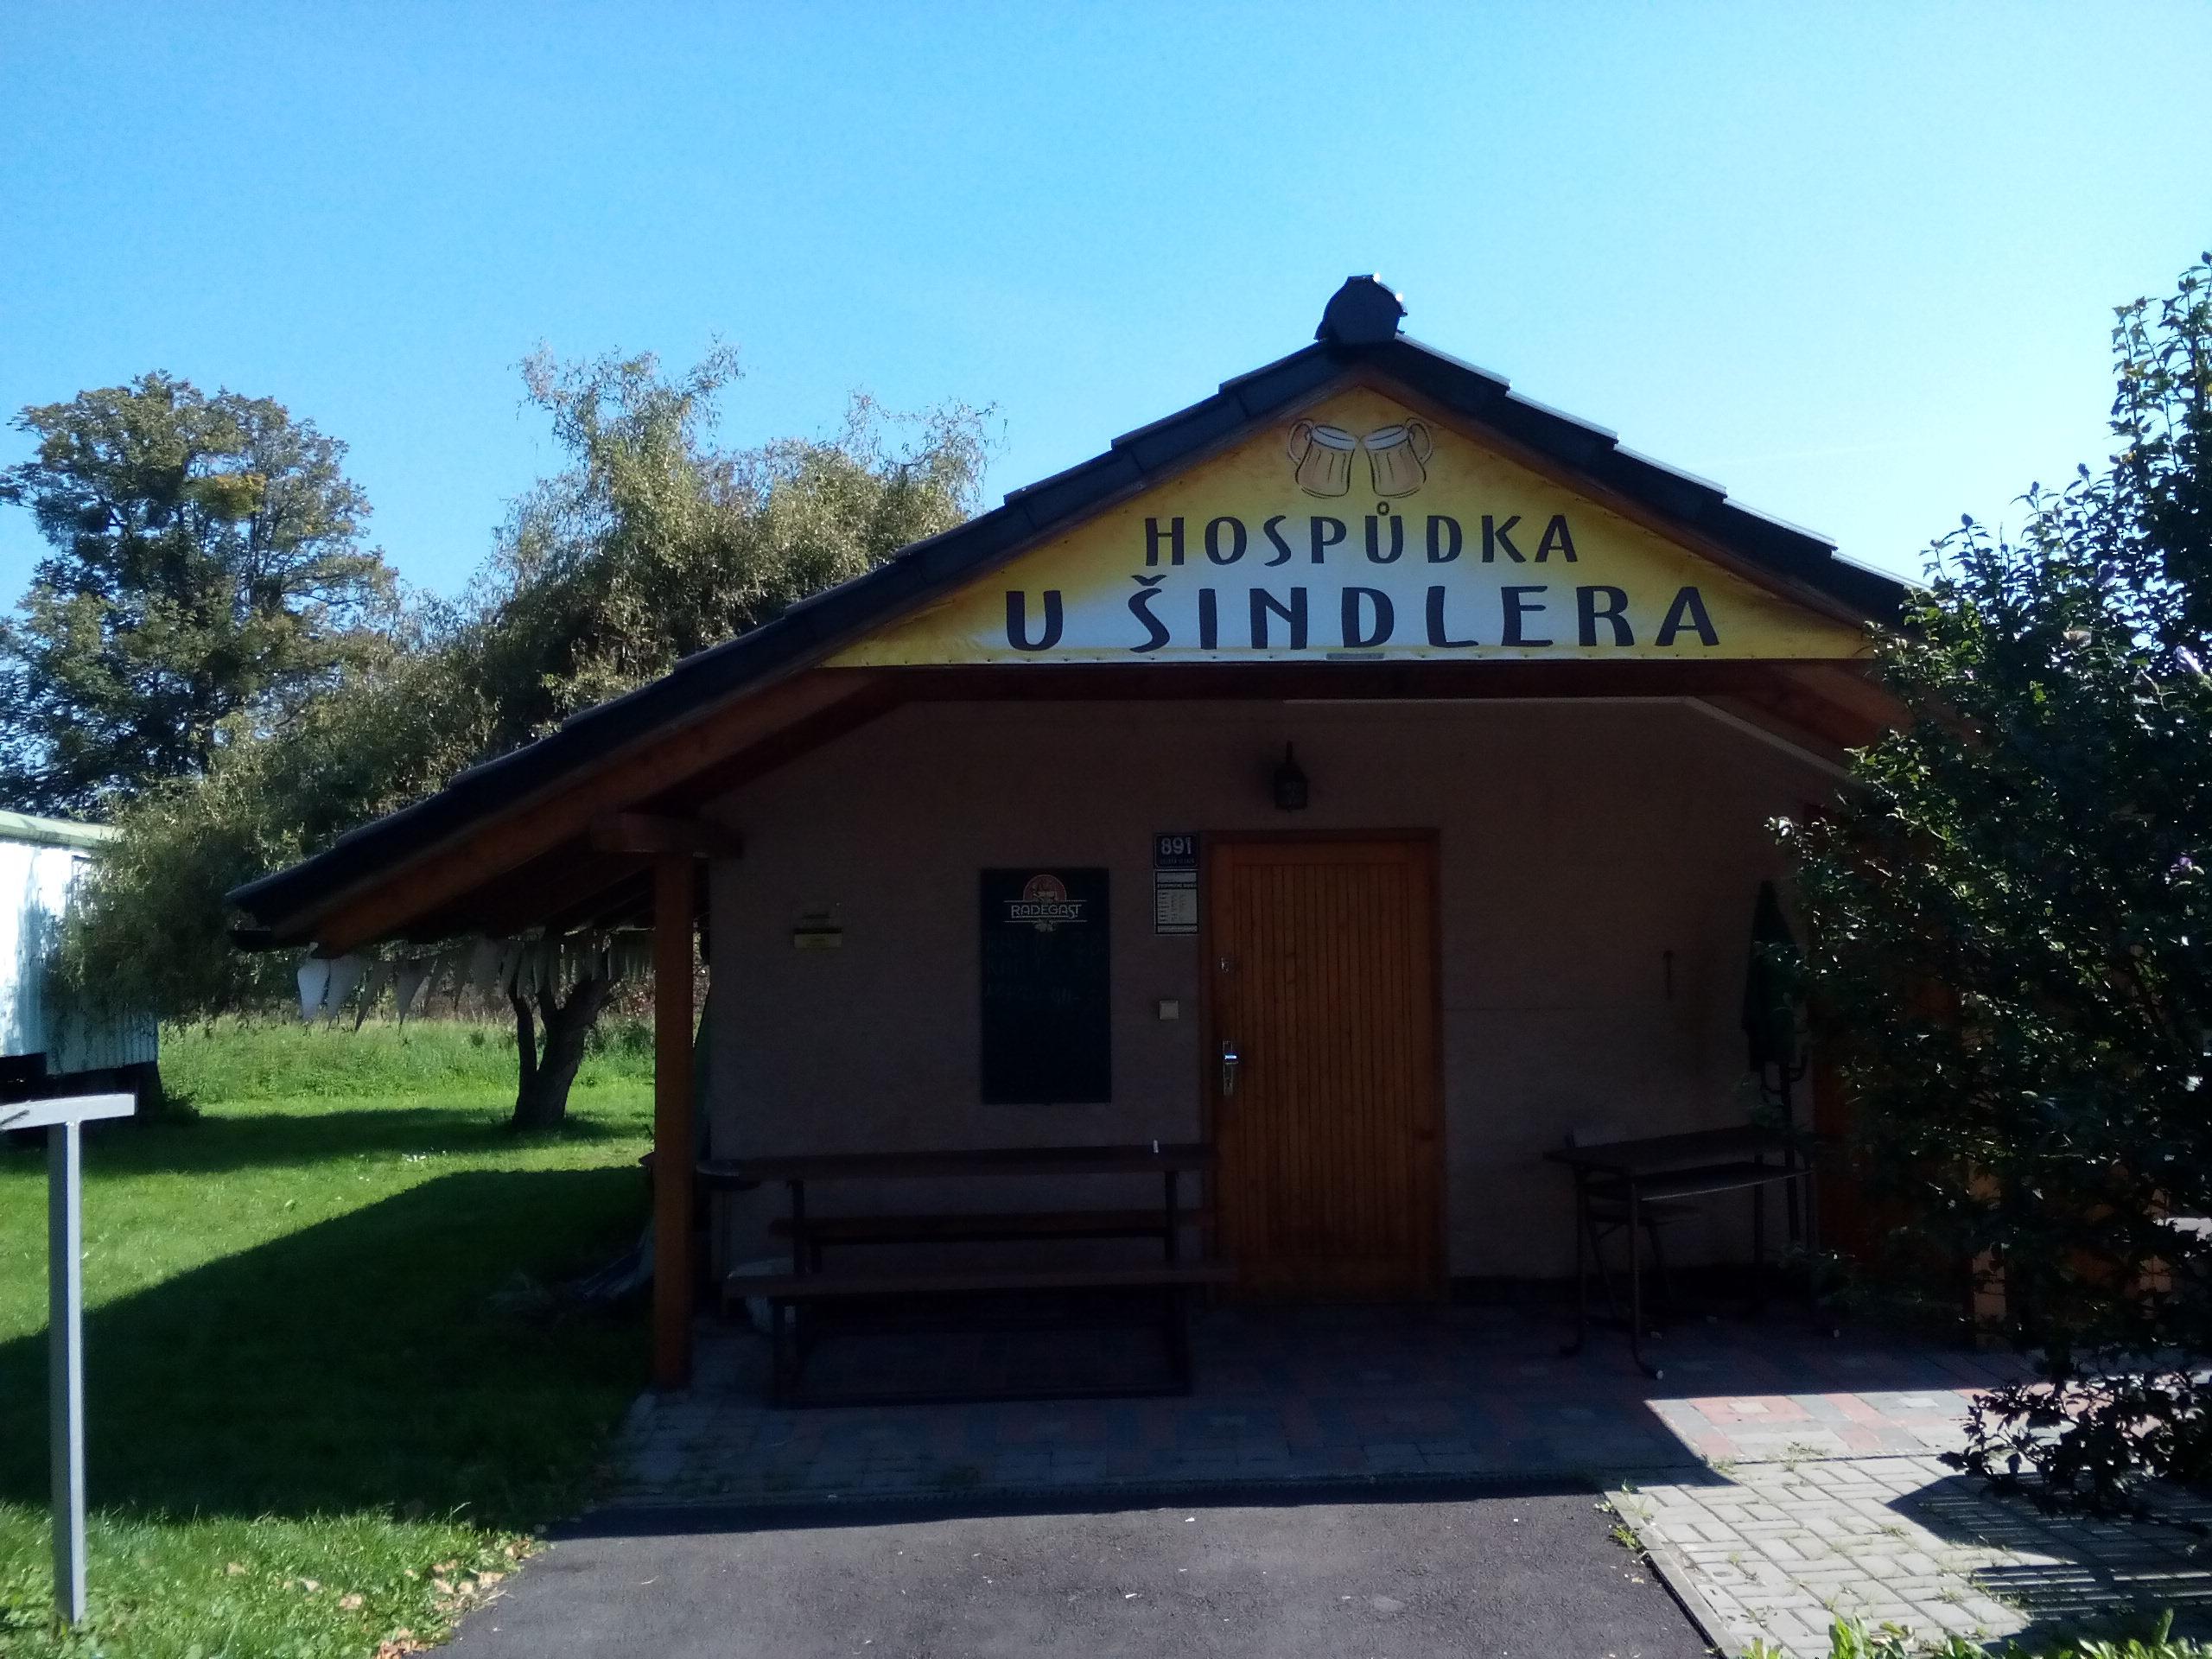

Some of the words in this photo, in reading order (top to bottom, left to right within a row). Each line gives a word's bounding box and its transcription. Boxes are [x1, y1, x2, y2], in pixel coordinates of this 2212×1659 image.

[1145, 501, 1579, 567] HOSPŮDKA
[1005, 590, 1063, 652] U
[1129, 575, 1719, 653] ŠINDLERA
[1160, 836, 1192, 855] 891
[1010, 904, 1082, 919] RADEGAST
